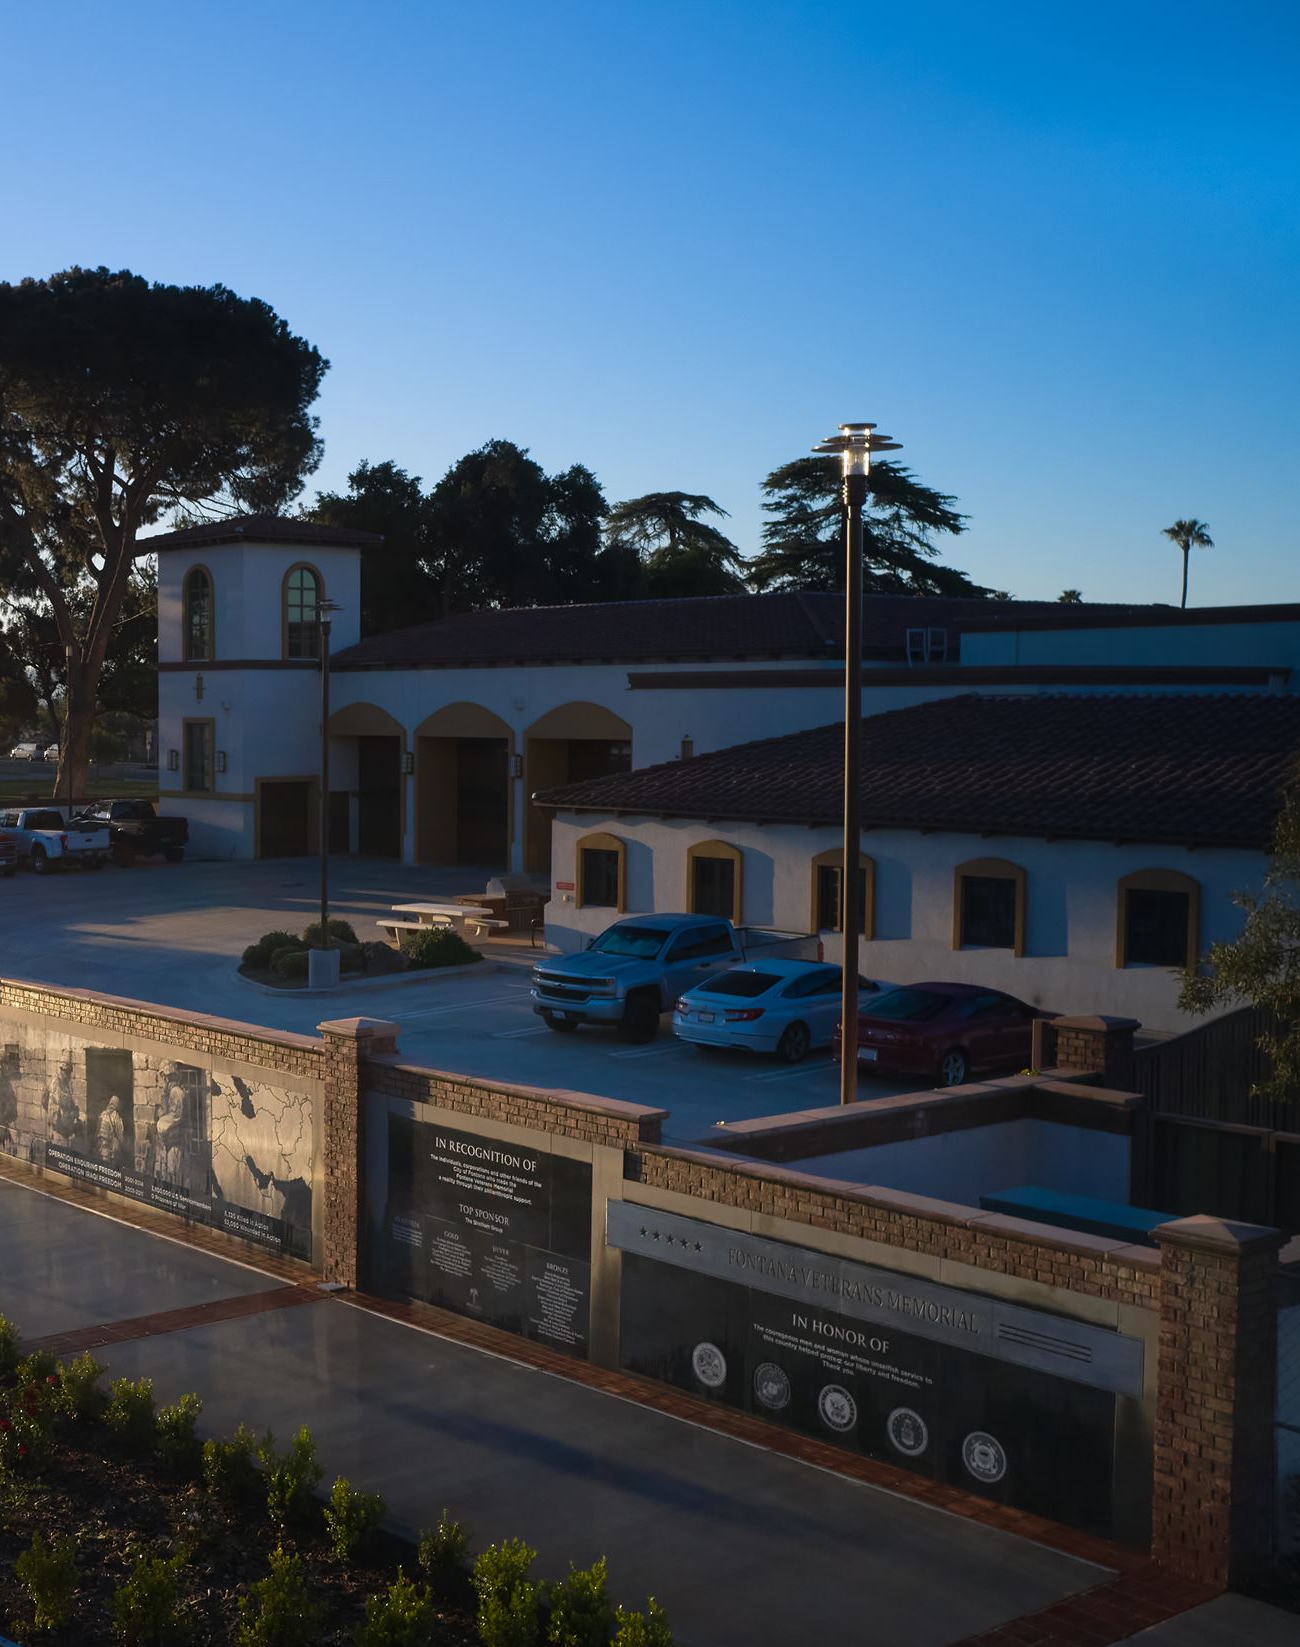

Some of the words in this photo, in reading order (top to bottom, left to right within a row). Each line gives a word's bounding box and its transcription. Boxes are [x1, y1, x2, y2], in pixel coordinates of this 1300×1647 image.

[48, 1149, 73, 1162] OPERATION
[74, 1157, 98, 1171] ENDURING
[99, 1165, 122, 1178] FREEDOM
[435, 1136, 446, 1149] IN
[449, 1140, 520, 1168] RECOGNITION
[523, 1159, 537, 1172] OF
[58, 1162, 84, 1176] OPERATION
[85, 1171, 98, 1181] IRAQI
[99, 1175, 122, 1188] FREEDOM
[458, 1203, 473, 1215] TOP
[474, 1207, 510, 1226] SPONSOR
[444, 1230, 459, 1241] GOLD
[546, 1262, 569, 1275] BRONZE
[728, 1248, 797, 1282] FONTANA
[801, 1268, 884, 1306] VETERANS
[887, 1290, 980, 1334] MEMORIAL
[791, 1313, 808, 1329] IN
[812, 1319, 867, 1348] HONOR
[870, 1337, 890, 1353] OF
[753, 1323, 764, 1332] The
[799, 1338, 812, 1346] men
[813, 1342, 826, 1351] and
[850, 1353, 870, 1365] whose
[900, 1369, 923, 1381] service
[925, 1376, 933, 1385] to
[763, 1334, 774, 1343] this
[775, 1339, 798, 1351] country
[843, 1359, 854, 1367] our
[855, 1362, 876, 1376] liberty
[877, 1369, 890, 1379] and
[822, 1359, 841, 1372] Thank
